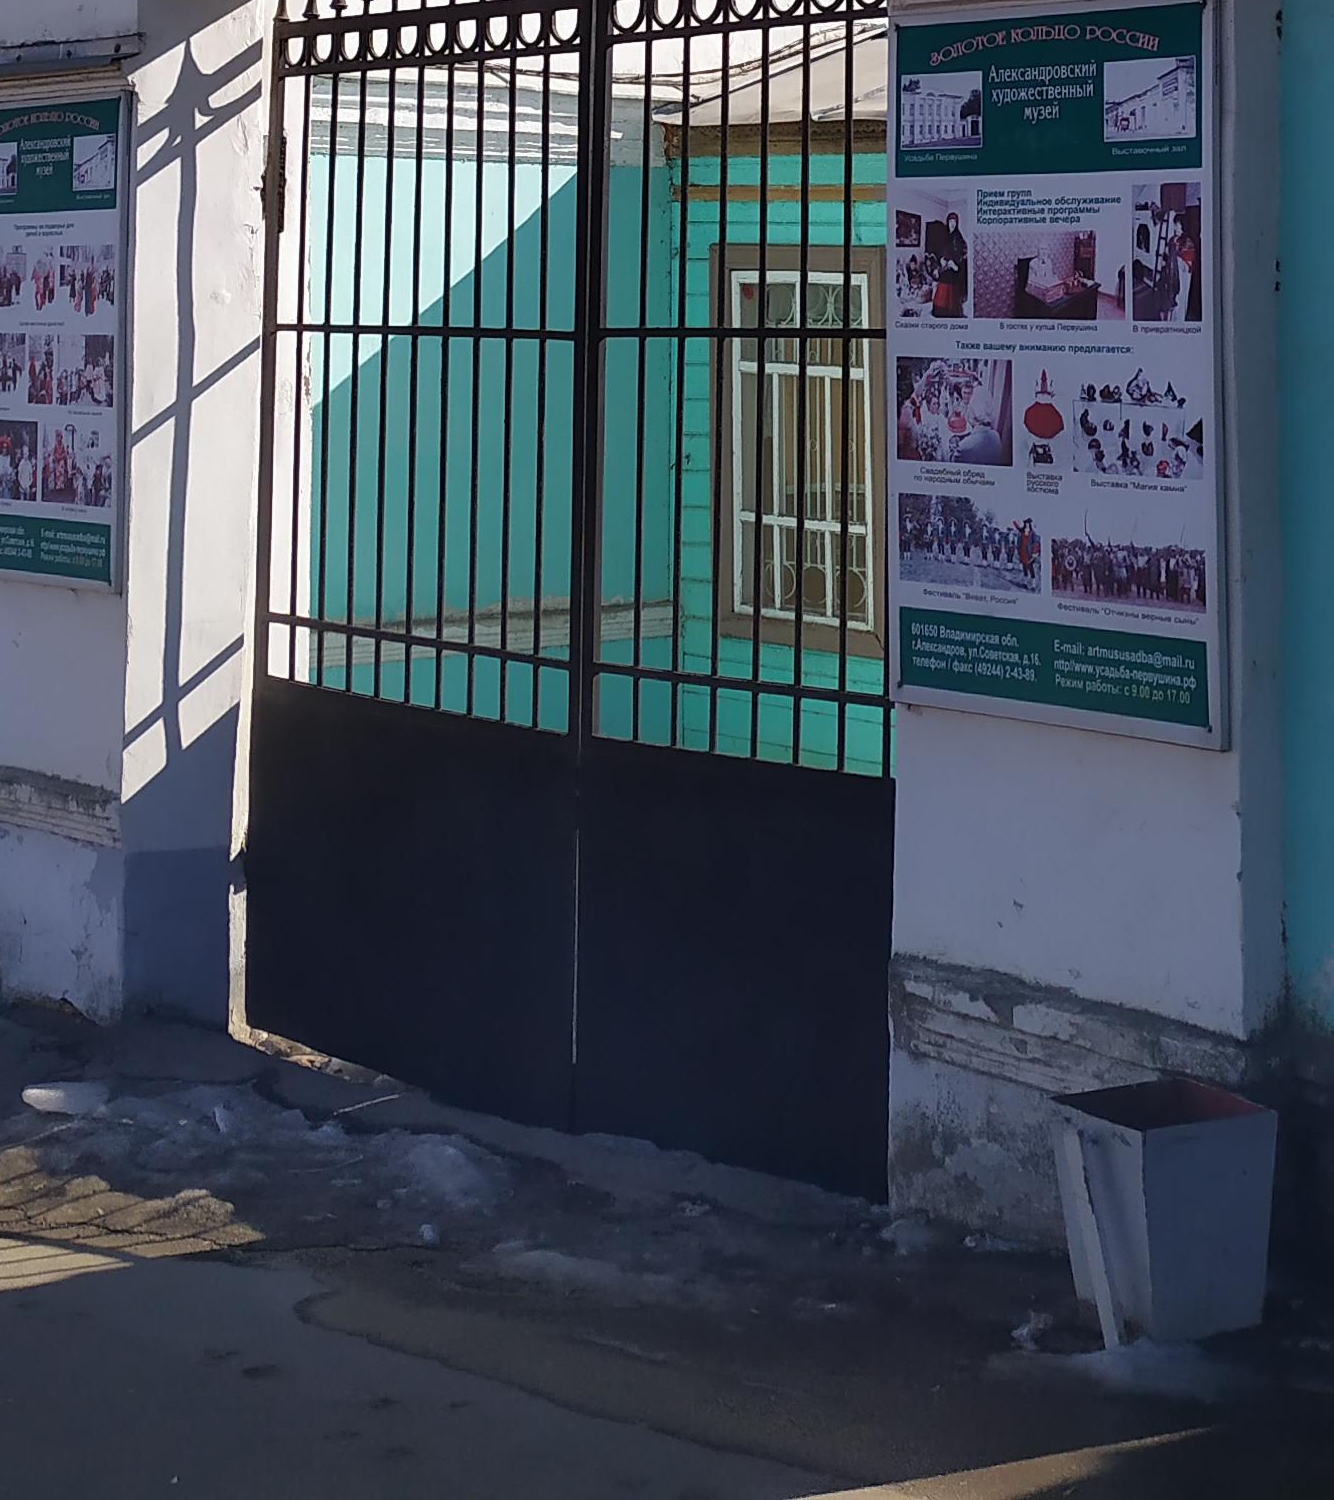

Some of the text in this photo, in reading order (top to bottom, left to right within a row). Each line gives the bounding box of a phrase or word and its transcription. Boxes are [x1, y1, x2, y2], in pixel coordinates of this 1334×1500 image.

[930, 24, 1160, 66] ЗОЛОТОЕ КОЛЬЦО РОССИИ
[988, 59, 1097, 85] Александровский
[991, 80, 1094, 106] художественный
[1024, 102, 1060, 124] музей
[1112, 144, 1187, 156] Выставочный зал
[903, 152, 978, 163] Усадьба Первушина
[977, 190, 1032, 199] Прием групп
[977, 196, 1122, 208] Индивидуальное обслуживание
[977, 206, 1100, 216] Интерактивные программы
[977, 215, 1081, 225] Корпоративные вечера
[895, 321, 969, 331] Сказки старого дома
[1140, 326, 1202, 334] привратницкой
[955, 340, 1134, 354] Также вашему вниманию предлагается:
[920, 466, 985, 479] Свадебный обряд
[1026, 471, 1063, 481] Выставка
[1026, 480, 1059, 488] русского
[1091, 479, 1128, 489] Выставка
[923, 588, 961, 599] Фестиваль
[1057, 602, 1099, 614] Фестиваль
[940, 626, 999, 645] Владимирская
[1001, 634, 1019, 647] обл.
[1054, 639, 1085, 656] E-mail:
[912, 655, 946, 671] телефон
[952, 659, 973, 674] факс
[1055, 673, 1083, 689] Режим
[1085, 679, 1122, 694] работы:
[1152, 690, 1164, 701] до
